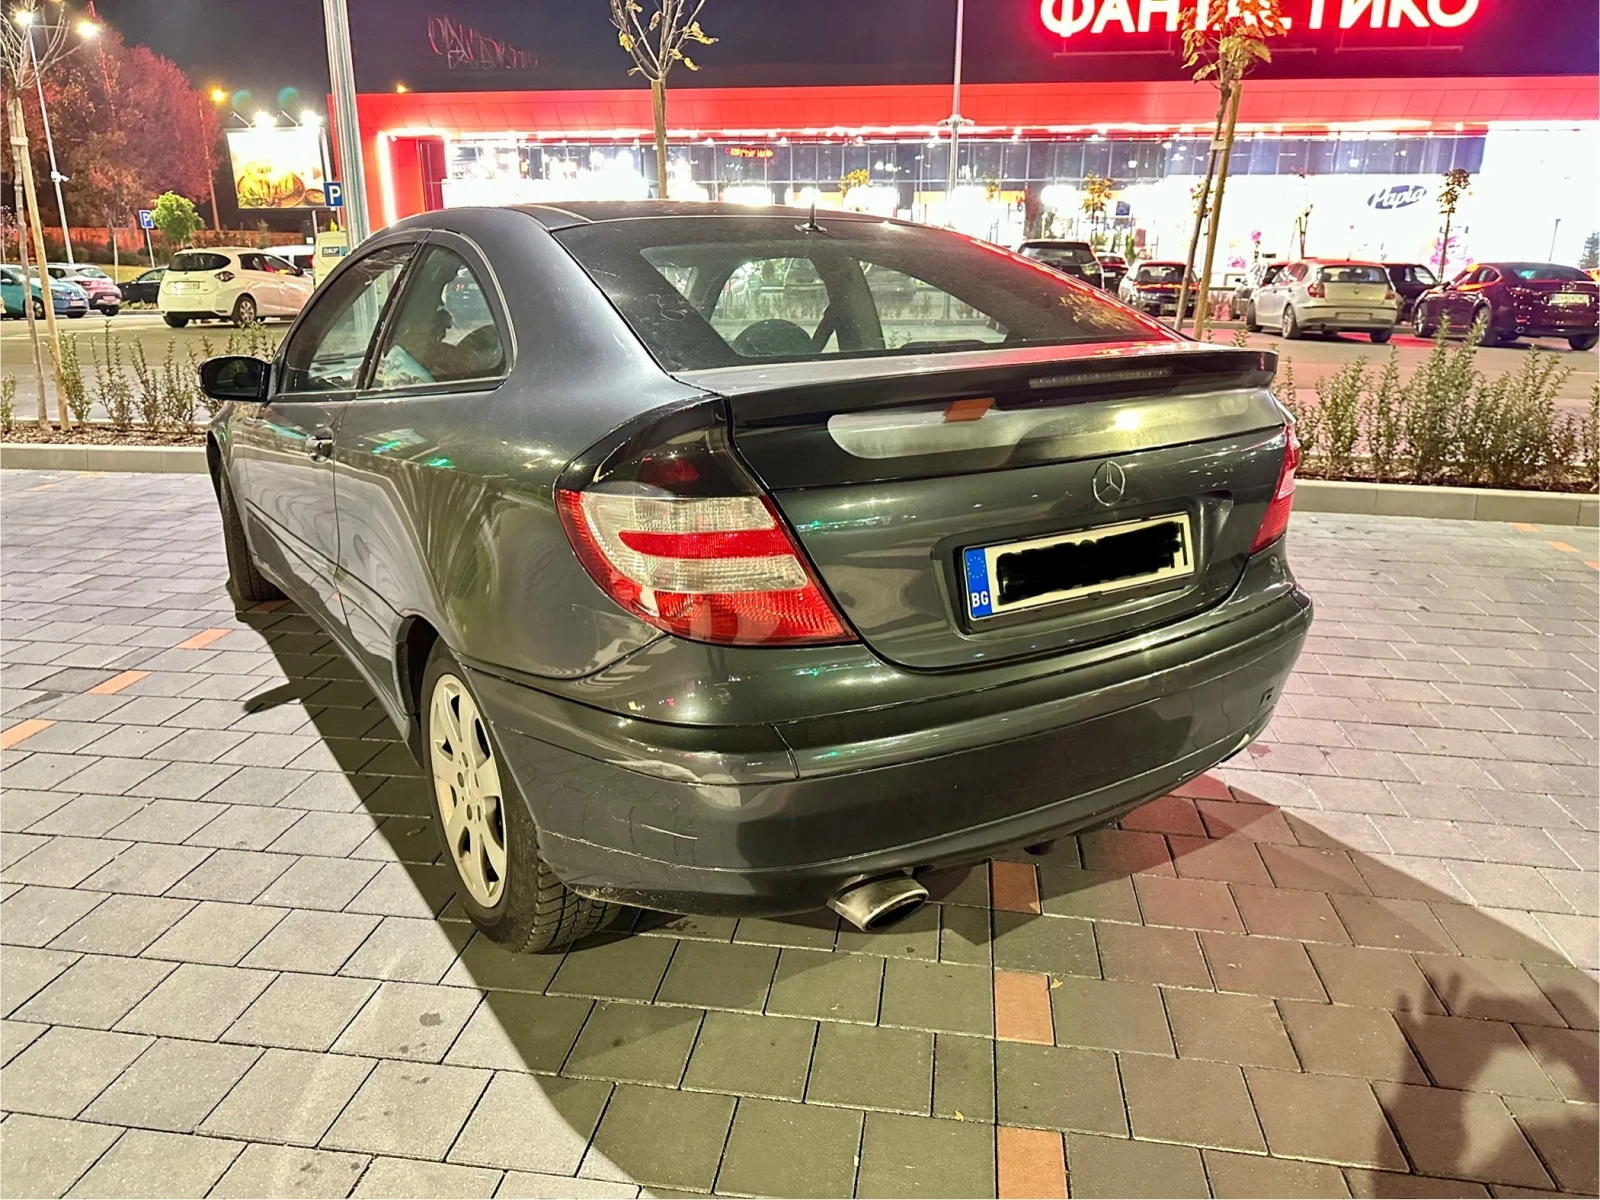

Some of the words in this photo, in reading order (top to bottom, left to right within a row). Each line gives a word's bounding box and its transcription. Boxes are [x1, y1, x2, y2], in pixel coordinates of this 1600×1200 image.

[1040, 0, 1480, 37] ФАНИКО
[328, 185, 341, 205] P
[971, 590, 989, 608] BG
